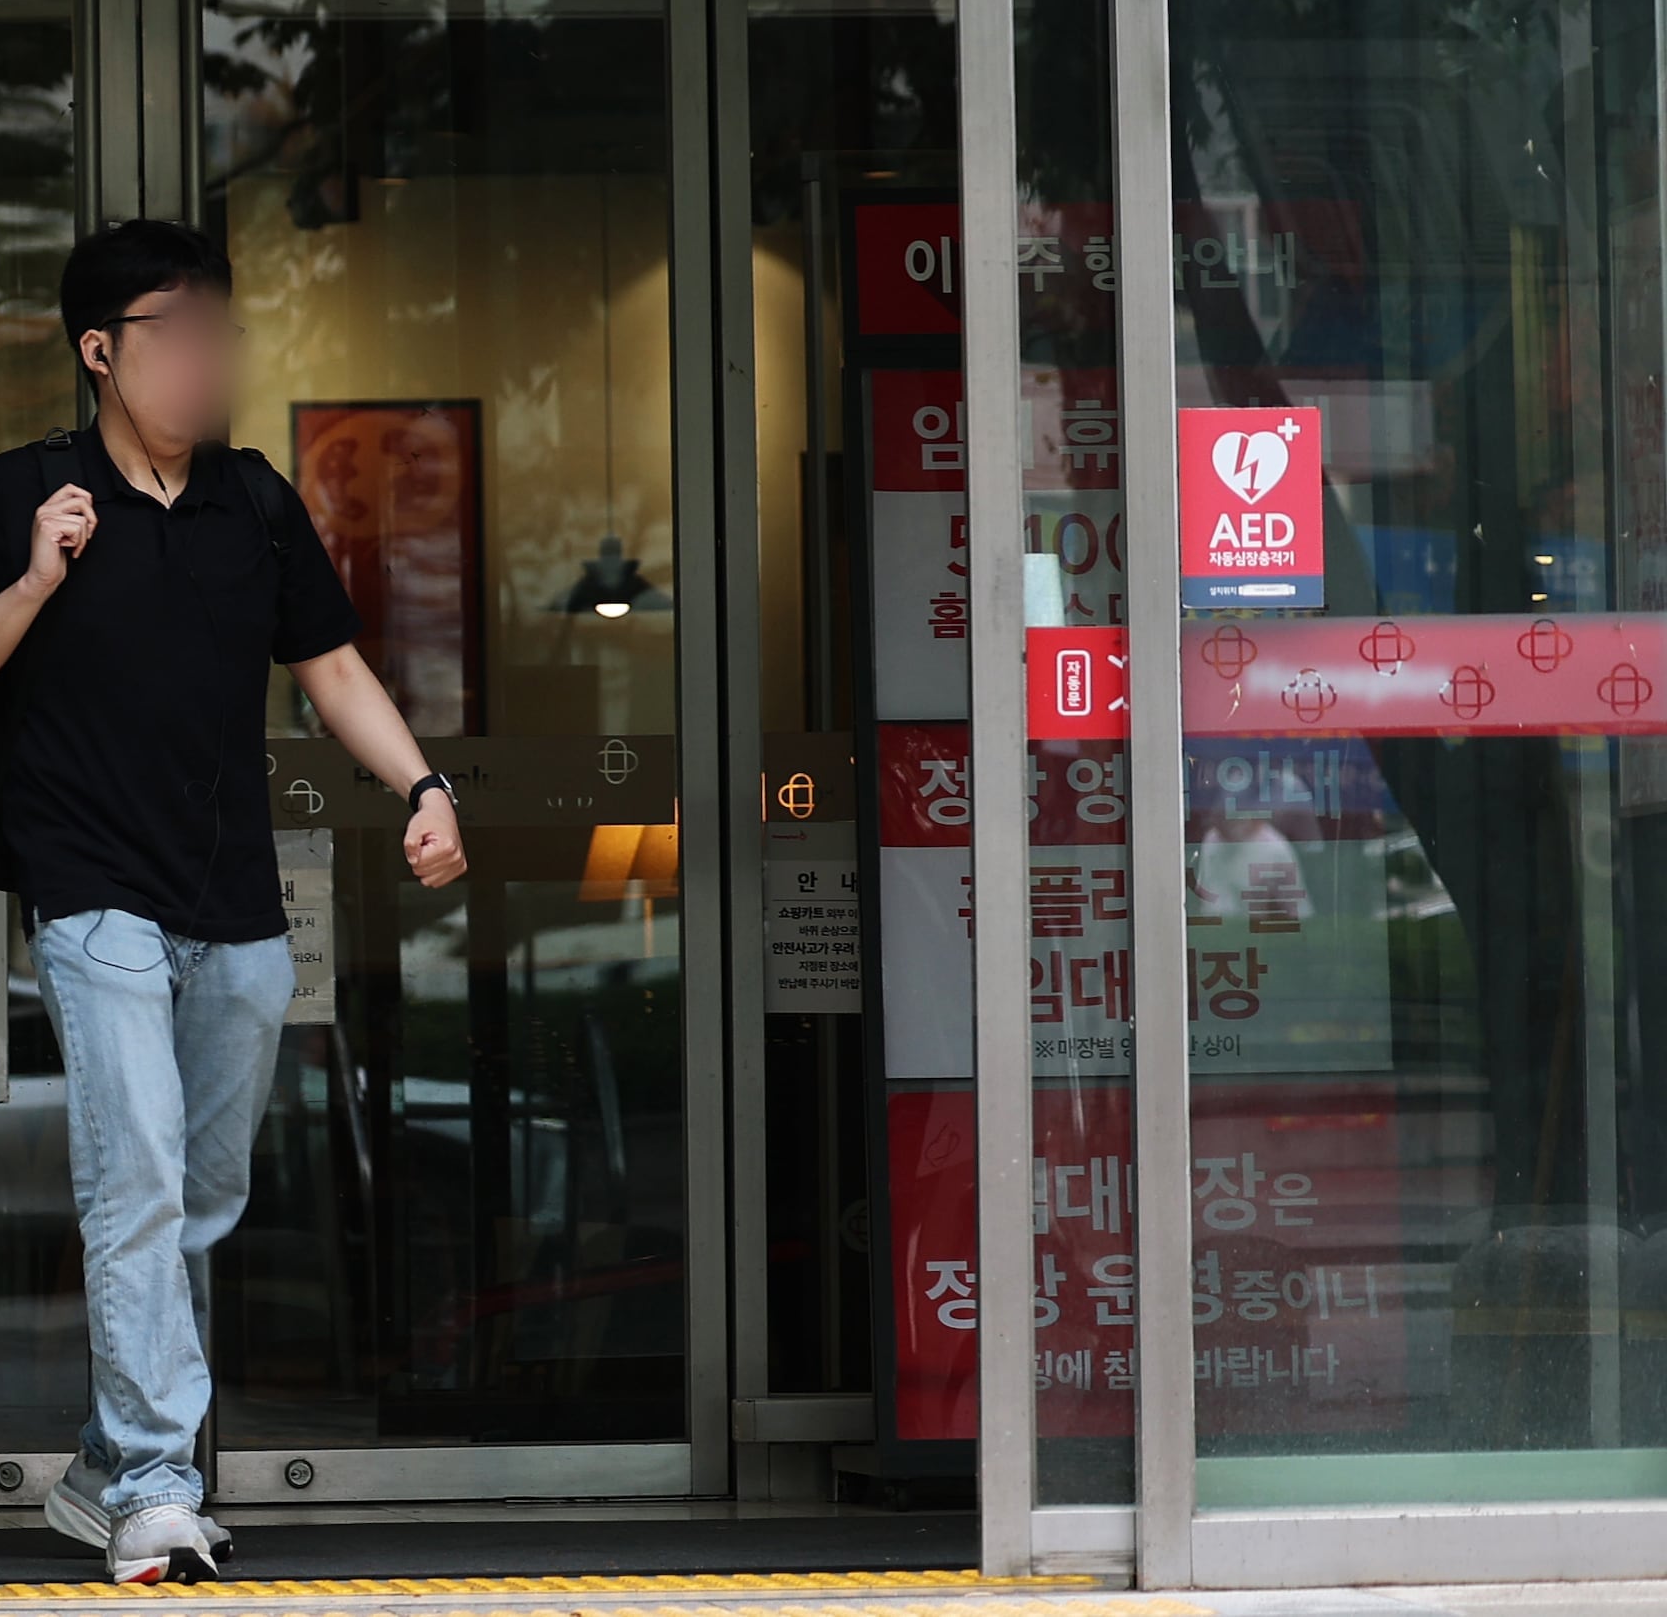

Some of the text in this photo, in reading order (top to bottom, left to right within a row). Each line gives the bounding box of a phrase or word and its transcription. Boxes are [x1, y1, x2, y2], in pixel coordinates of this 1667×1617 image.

[1209, 513, 1295, 548] AED
[1209, 551, 1295, 567] 자동심장충격기
[1065, 660, 1083, 709] 자동문
[1216, 749, 1342, 821] 안내
[1240, 862, 1307, 934] 몰
[778, 907, 846, 920] 쇼핑카트 외부
[305, 917, 315, 928] 시
[799, 925, 860, 937] 바퀴 손상으로
[772, 942, 855, 955] 안전사고가 우려
[293, 952, 323, 964] 되오니
[799, 960, 828, 973] 지정된
[1203, 1035, 1242, 1058] 상이
[1194, 1343, 1340, 1389] 바랍니다
